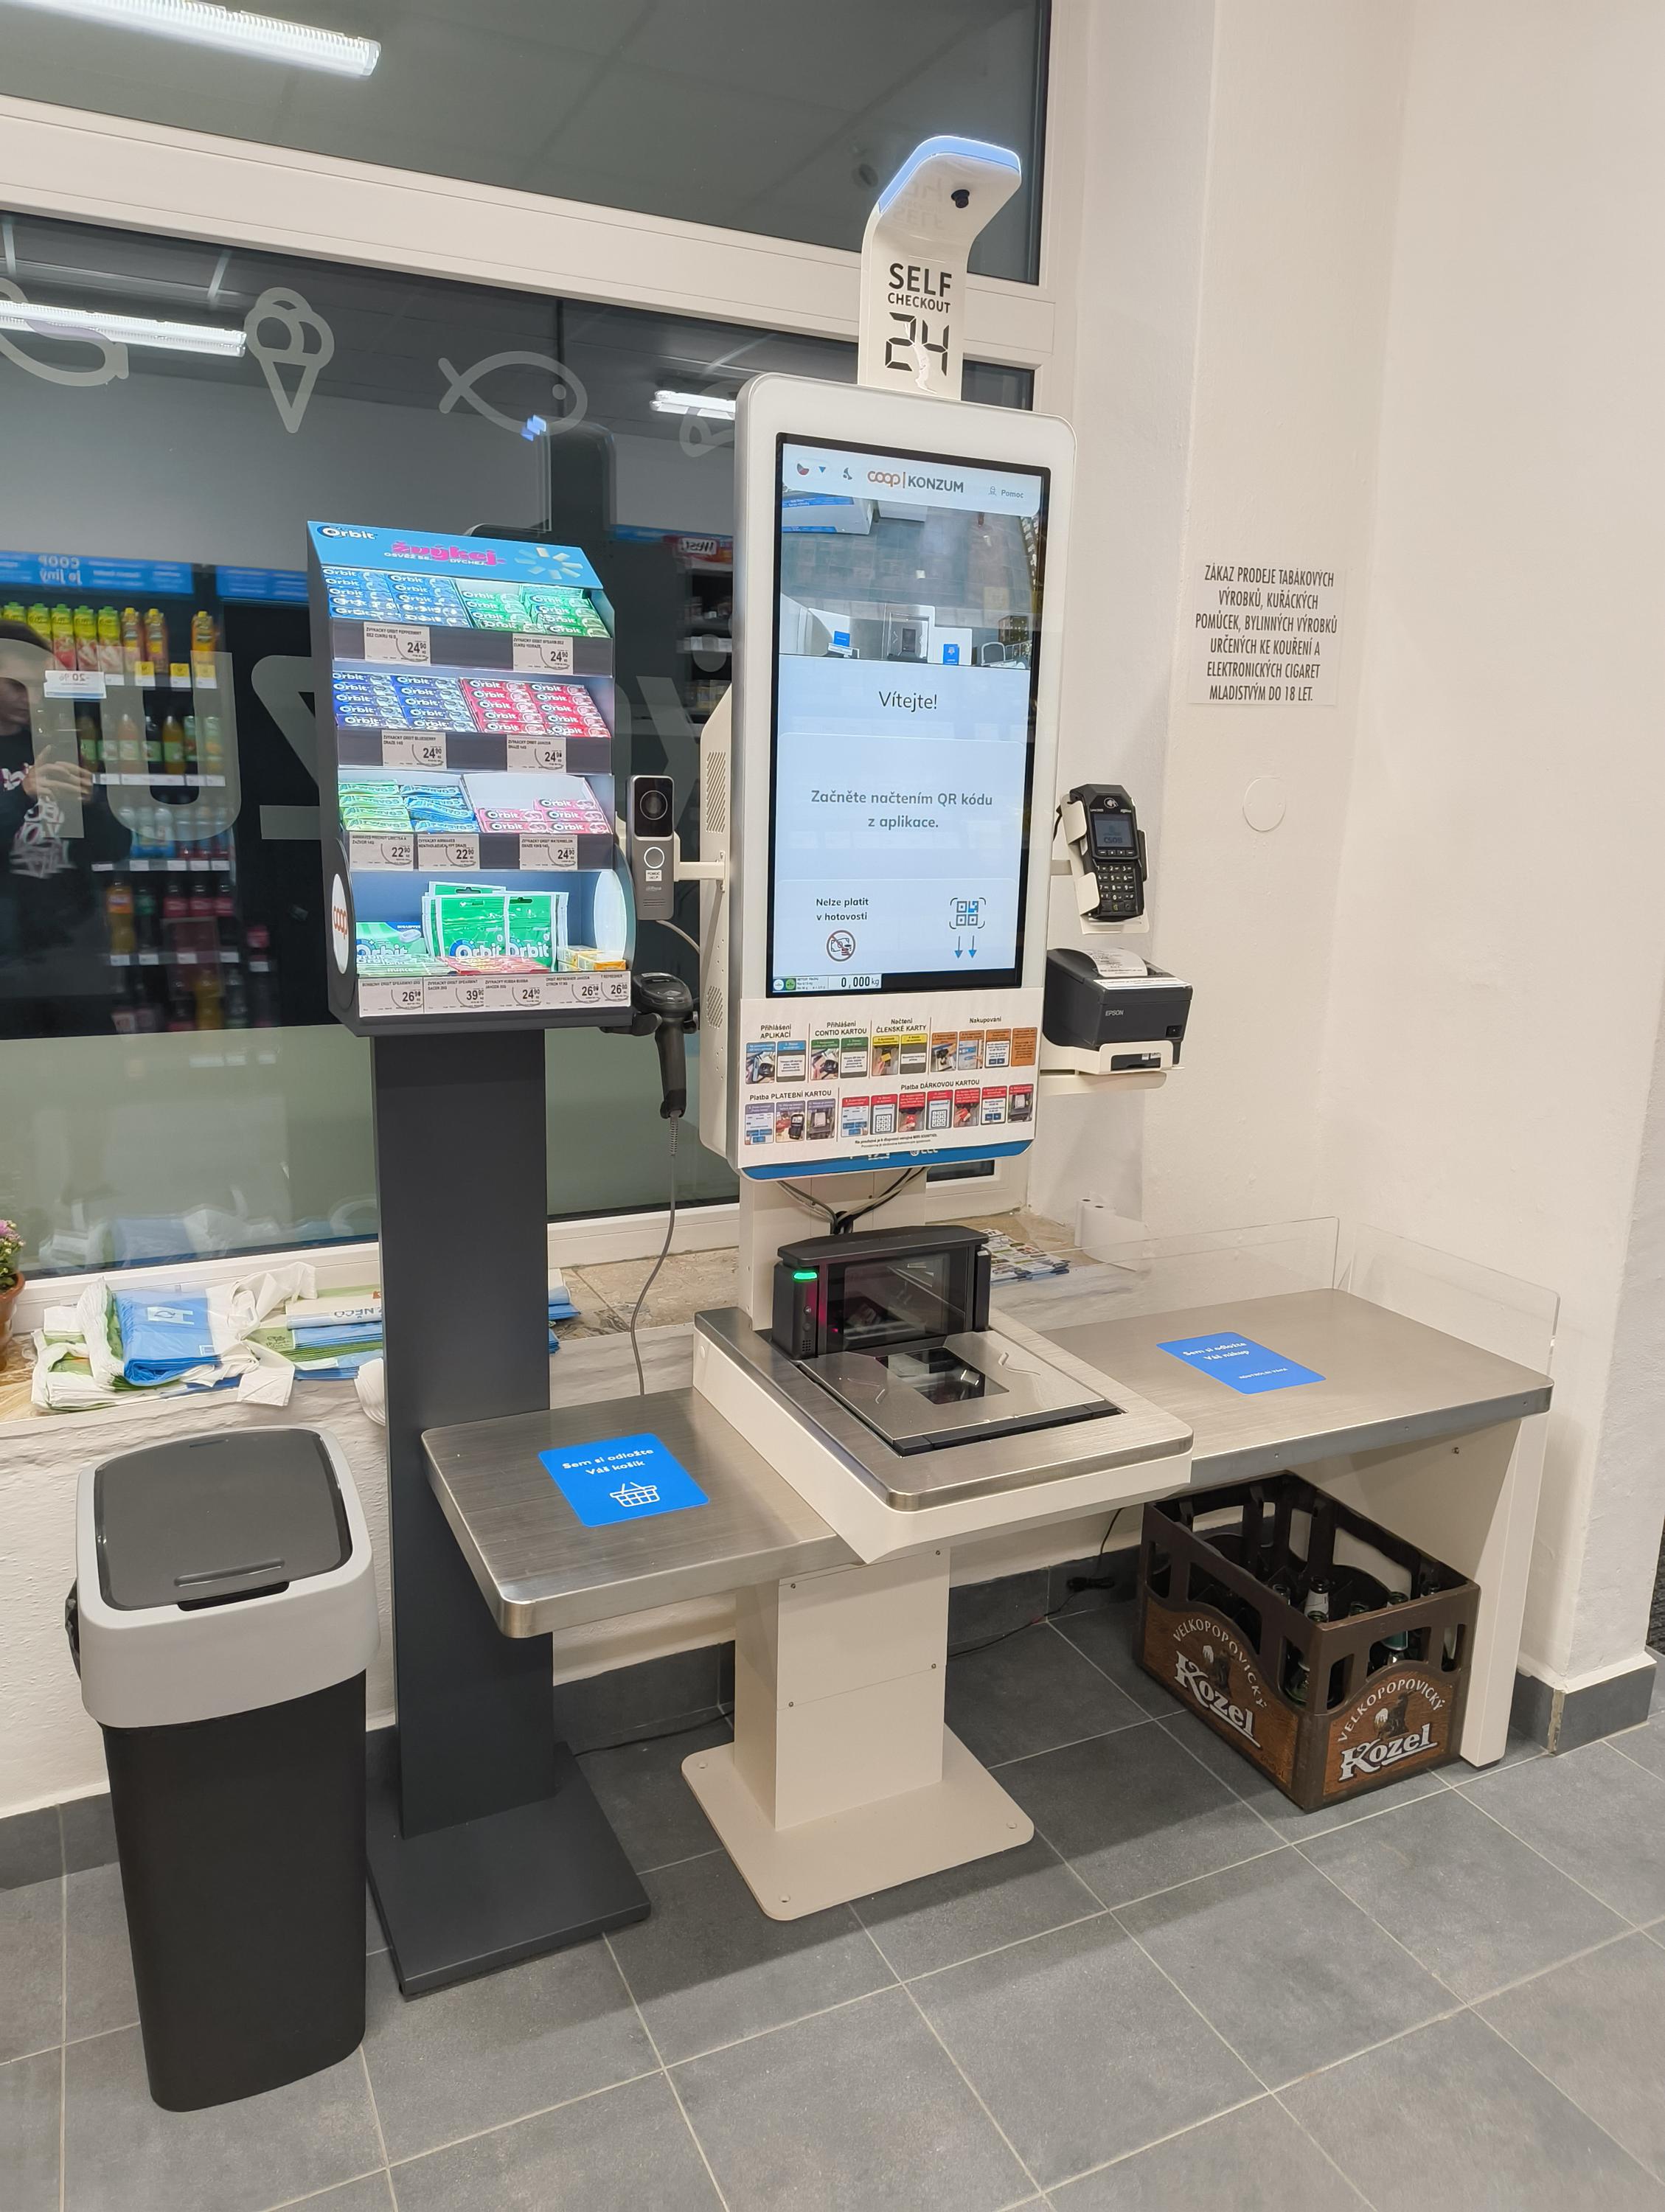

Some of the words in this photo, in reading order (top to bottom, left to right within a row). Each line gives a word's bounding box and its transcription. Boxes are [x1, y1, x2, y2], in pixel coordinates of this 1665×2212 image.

[889, 262, 952, 297] SELF
[888, 292, 950, 313] CHECKOUT
[885, 312, 950, 376] 24
[867, 470, 901, 487] coop
[908, 476, 964, 493] KONZUM
[1001, 489, 1024, 498] Pomoc
[321, 526, 377, 540] Orbit
[323, 568, 357, 577] Orbit
[1205, 563, 1234, 582] ZÁKAZ
[1237, 566, 1276, 584] PRODEJE
[1279, 567, 1335, 588] TABÁKOVÝCH
[390, 575, 423, 583] Orbit
[462, 591, 496, 599] Orbit
[1219, 586, 1264, 611] VÝROBKŮ,
[1267, 589, 1318, 610] KUŘÁCKÝCH
[466, 600, 499, 609] Orbit
[472, 611, 505, 620] Orbit
[1195, 610, 1241, 633] POMŮCEK,
[1245, 613, 1294, 632] BYLINNÝCH
[1297, 613, 1338, 633] VÝROBKŮ
[550, 625, 582, 634] Orbit
[407, 641, 420, 653] 24
[1210, 634, 1256, 654] URČENÝCH
[1259, 639, 1271, 655] KE
[1273, 637, 1313, 655] KOUŘENÍ
[1314, 641, 1321, 656] A
[550, 651, 562, 662] 24
[1207, 659, 1282, 678] ELEKTRONICKÝCH
[1285, 663, 1321, 678] CIGARET
[333, 672, 367, 681] Orbit
[397, 676, 432, 685] Orbit
[333, 683, 369, 692] Orbit
[470, 679, 501, 689] Orbit
[532, 684, 562, 692] Orbit
[401, 687, 437, 696] Orbit
[473, 690, 505, 699] Orbit
[1209, 682, 1265, 700] MLADISTVÝM
[1268, 686, 1282, 700] DO
[1285, 686, 1295, 701] 18
[1298, 686, 1313, 701] LET.
[336, 694, 372, 703] Orbit
[406, 698, 440, 706] Orbit
[537, 693, 567, 702] Orbit
[878, 691, 938, 713] Vítejte!
[339, 705, 377, 714] Orbit
[479, 700, 511, 709] Orbit
[541, 703, 572, 712] Orbit
[411, 708, 446, 717] Orbit
[485, 711, 517, 720] Orbit
[344, 716, 381, 726] Orbit
[414, 719, 450, 728] Orbit
[547, 714, 579, 723] Orbit
[487, 723, 520, 731] Orbit
[552, 725, 583, 734] Orbit
[423, 748, 436, 759] 24
[544, 751, 556, 762] 24
[540, 799, 572, 807] Orbit
[810, 790, 866, 804] Začněte
[871, 791, 933, 805] načtením
[937, 793, 957, 807] QR
[961, 793, 993, 806] kódu
[487, 810, 521, 820] Orbit
[549, 810, 581, 819] Orbit
[491, 822, 523, 831] Orbit
[553, 822, 585, 832] Orbit
[868, 818, 875, 827] z
[880, 815, 939, 830] aplikace.
[392, 846, 404, 858] 22
[456, 849, 468, 860] 22
[557, 849, 569, 860] 24
[816, 897, 842, 907] Nelze
[844, 897, 869, 908] platit
[824, 911, 868, 922] hotovosti
[455, 942, 502, 957] Orbit
[841, 975, 870, 989] 0,000
[871, 978, 880, 986] kg
[522, 989, 534, 1000] 24
[581, 986, 593, 996] 26
[611, 984, 622, 995] 26
[402, 991, 415, 1003] 26
[466, 989, 479, 1001] 39
[760, 1023, 792, 1032] Přihlášení
[876, 1026, 905, 1034] ČLENSKÉ
[920, 1081, 954, 1089] DÁRKOVOU
[955, 1079, 980, 1087] KARTOU
[771, 1090, 804, 1099] PLATEBNÍ
[804, 1090, 832, 1098] KARTOU
[1203, 1353, 1222, 1361] Váš
[1222, 1349, 1250, 1359] nákup
[562, 1459, 591, 1470] Sem
[594, 1455, 605, 1464] si
[607, 1448, 654, 1462] odložte
[585, 1466, 610, 1475] Váš
[611, 1459, 646, 1471] košík
[1173, 1618, 1268, 1708] VELKOPOPOVICKÝ
[1174, 1649, 1260, 1747] Kozel
[1338, 1677, 1447, 1742] VELKOPOPOVICKÝ
[1338, 1722, 1437, 1782] Kozel
